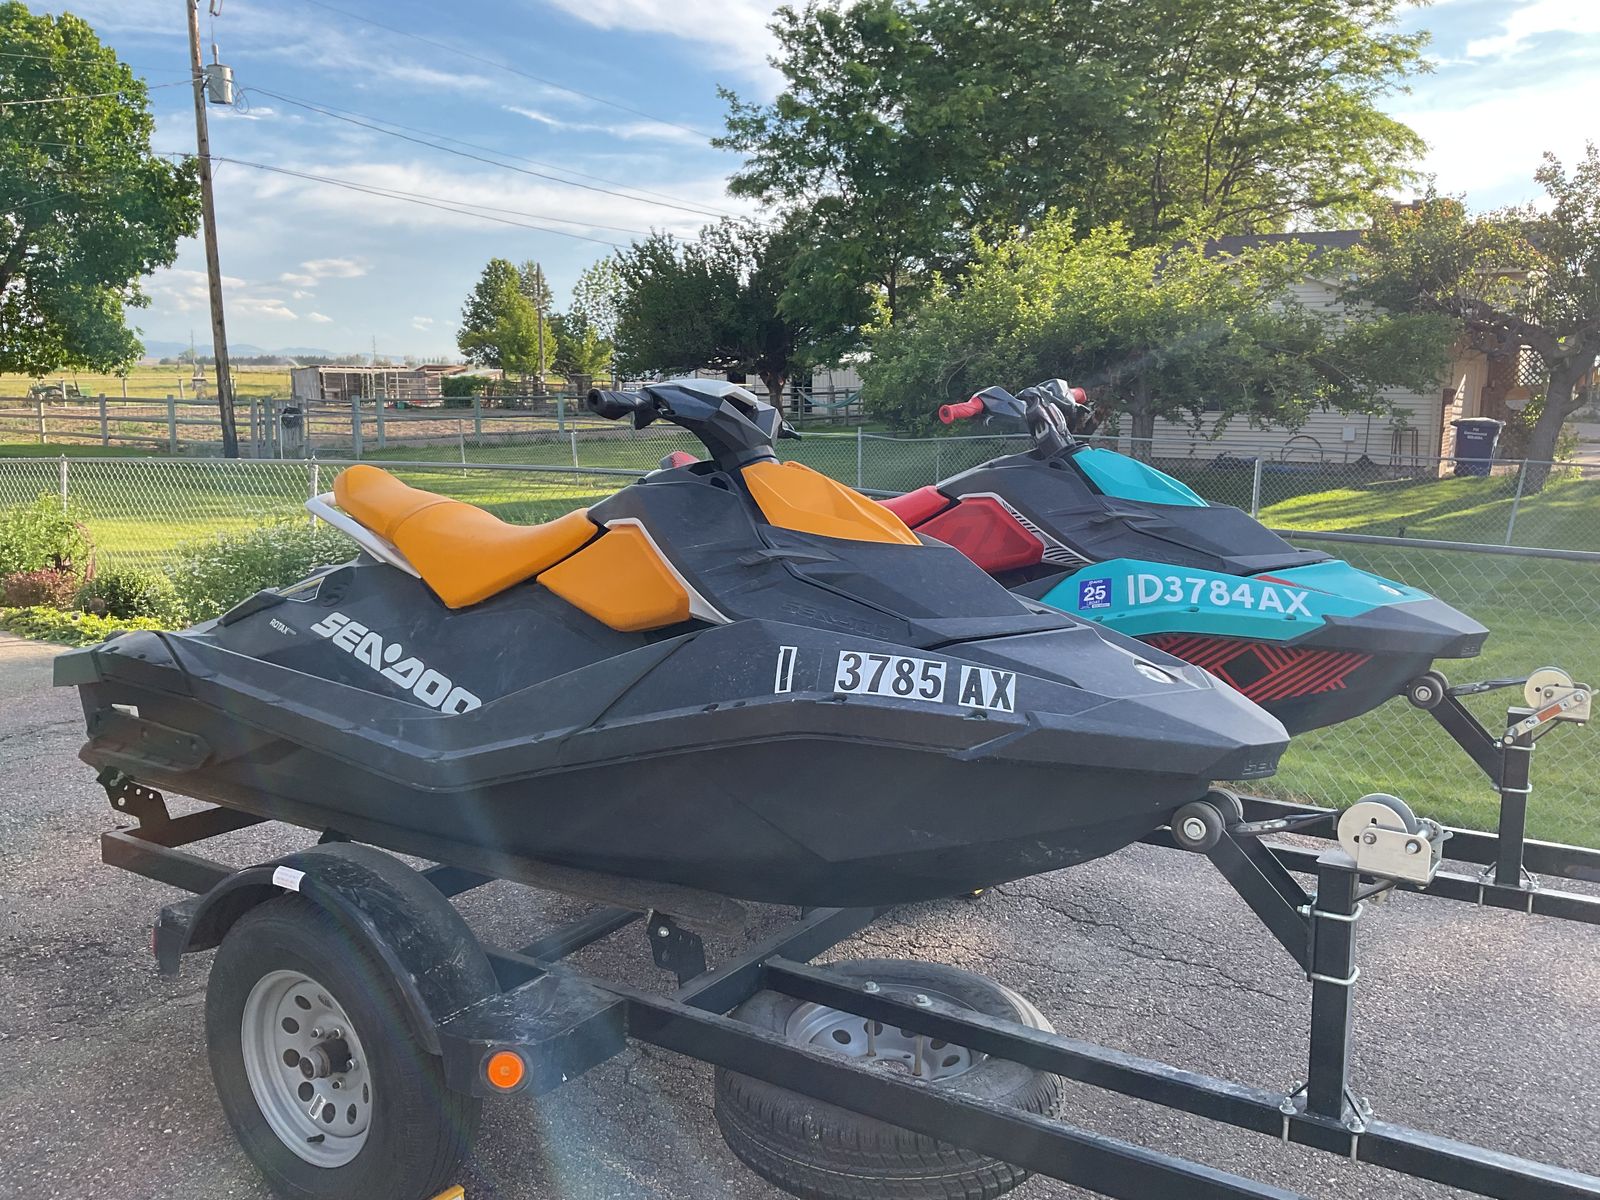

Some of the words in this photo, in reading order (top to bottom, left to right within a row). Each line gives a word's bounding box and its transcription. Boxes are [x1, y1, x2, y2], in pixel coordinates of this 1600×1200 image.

[1084, 586, 1106, 601] 25
[1127, 574, 1312, 617] ID3784AX
[269, 618, 289, 634] ROTAX
[837, 653, 943, 699] 3785
[961, 668, 1014, 711] AX
